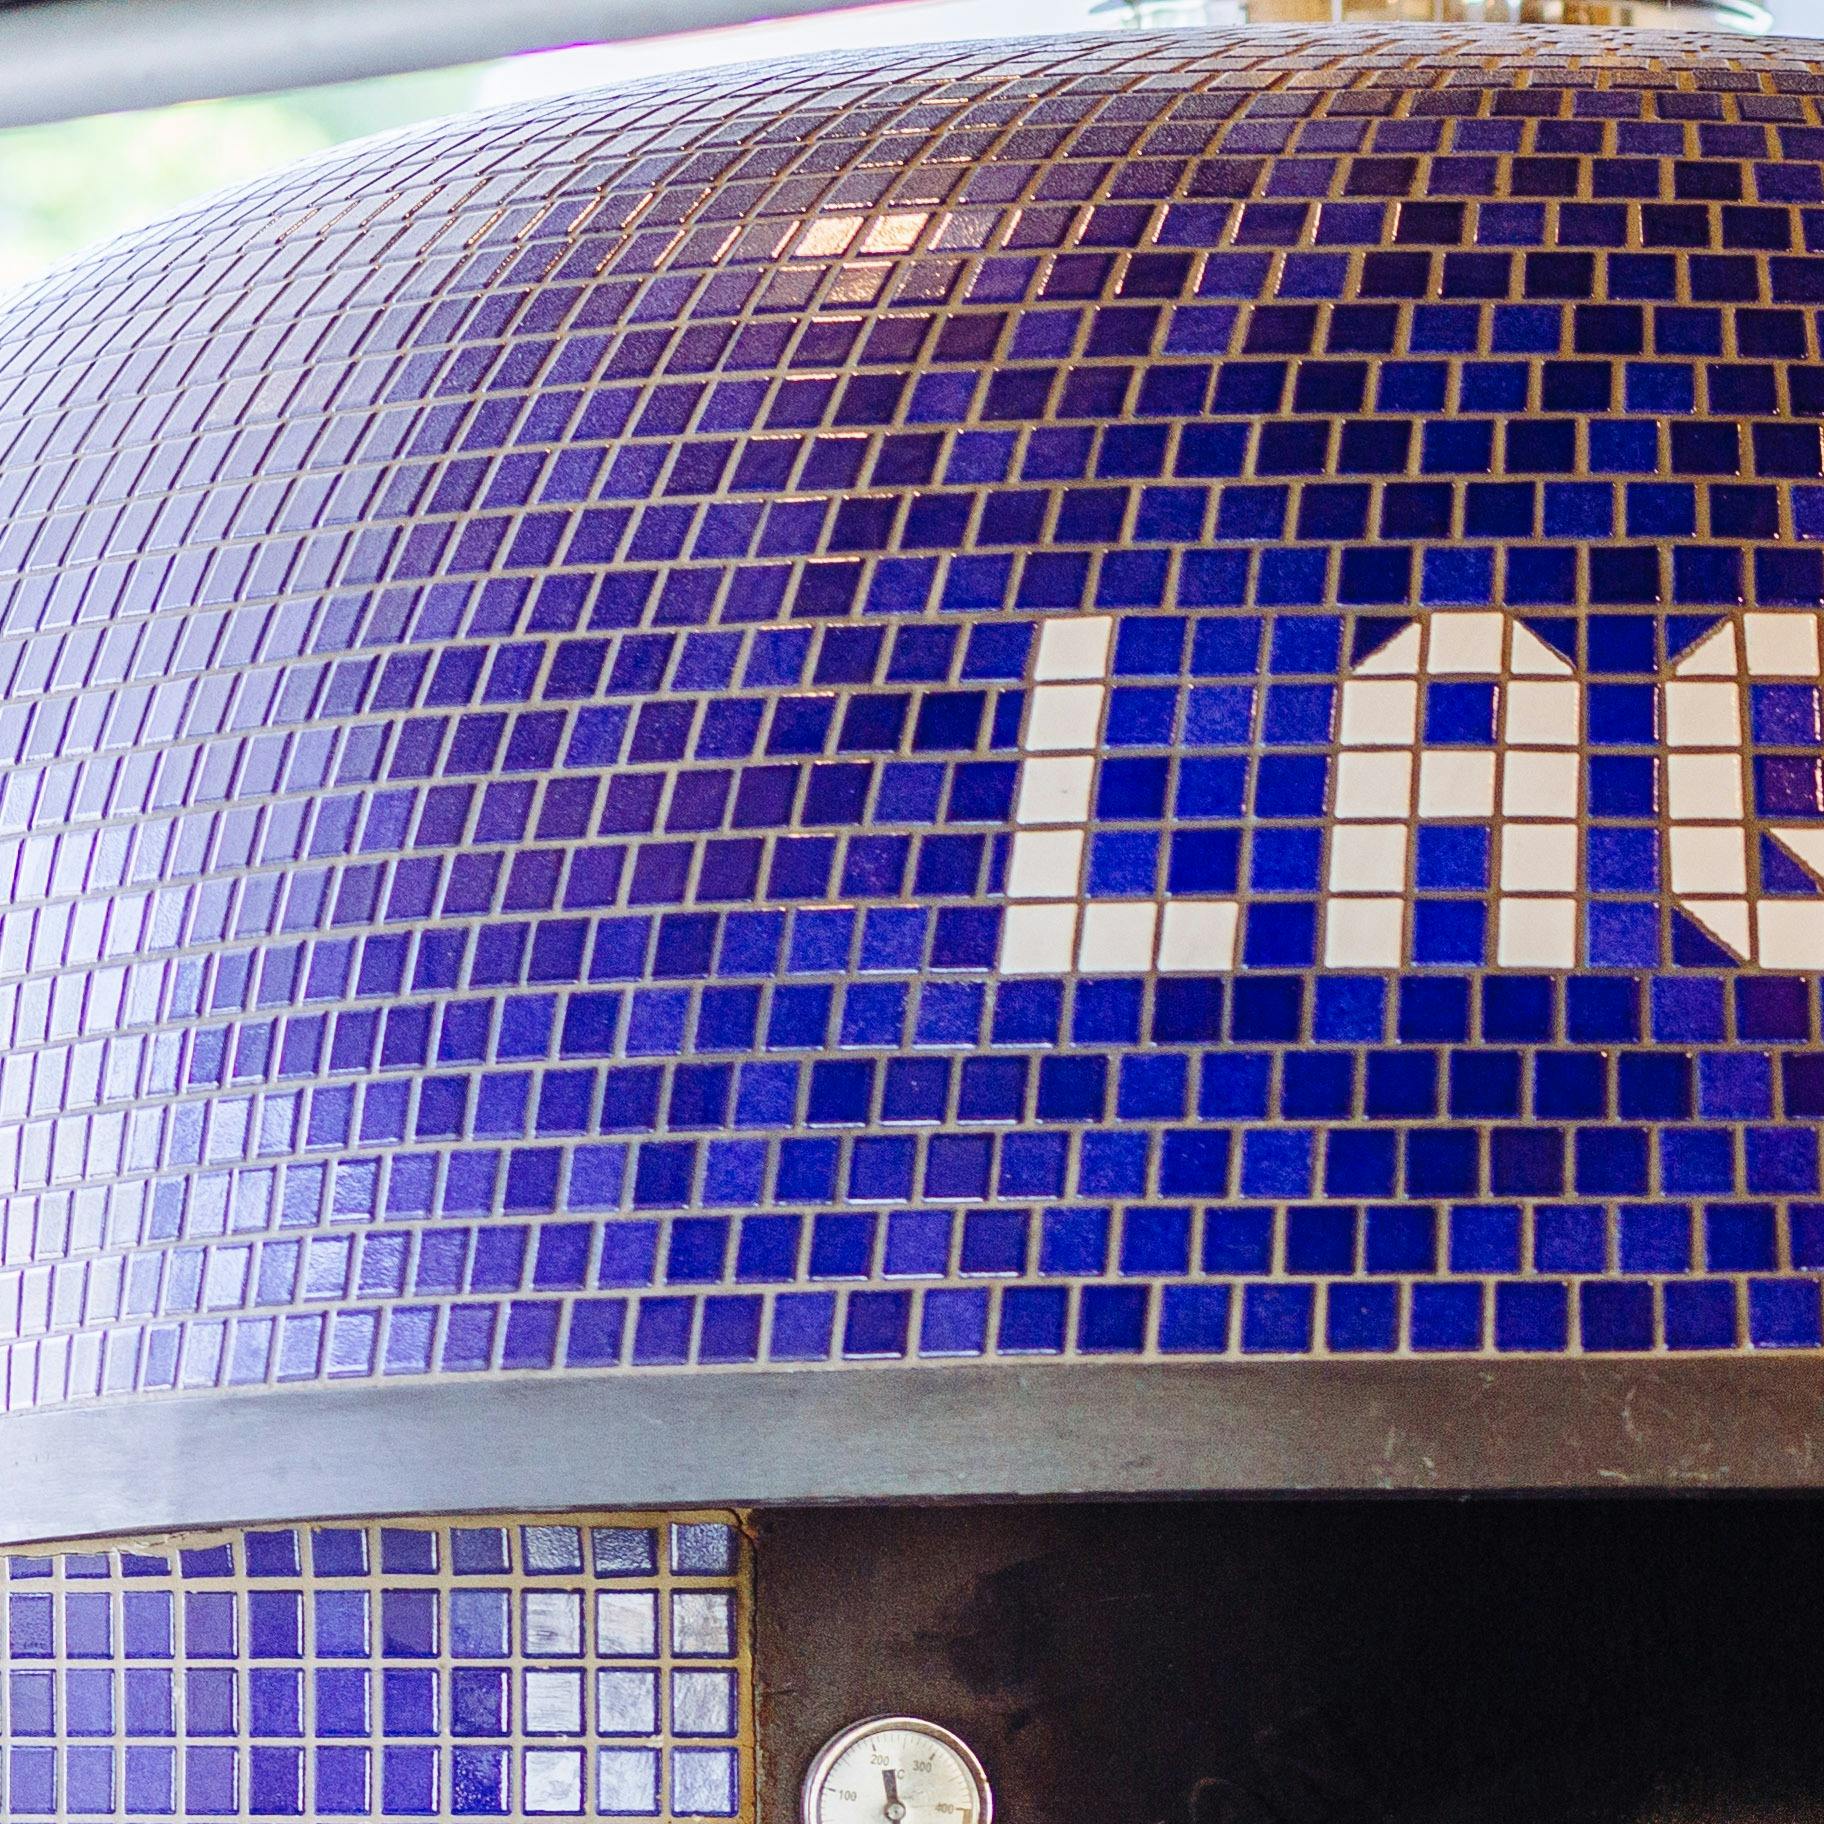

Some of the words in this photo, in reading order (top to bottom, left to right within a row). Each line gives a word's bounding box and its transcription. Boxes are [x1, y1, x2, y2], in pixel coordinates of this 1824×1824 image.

[870, 1754, 890, 1766] 200
[913, 1760, 932, 1773] 300
[839, 1790, 857, 1801] 100
[935, 1803, 954, 1814] 400
